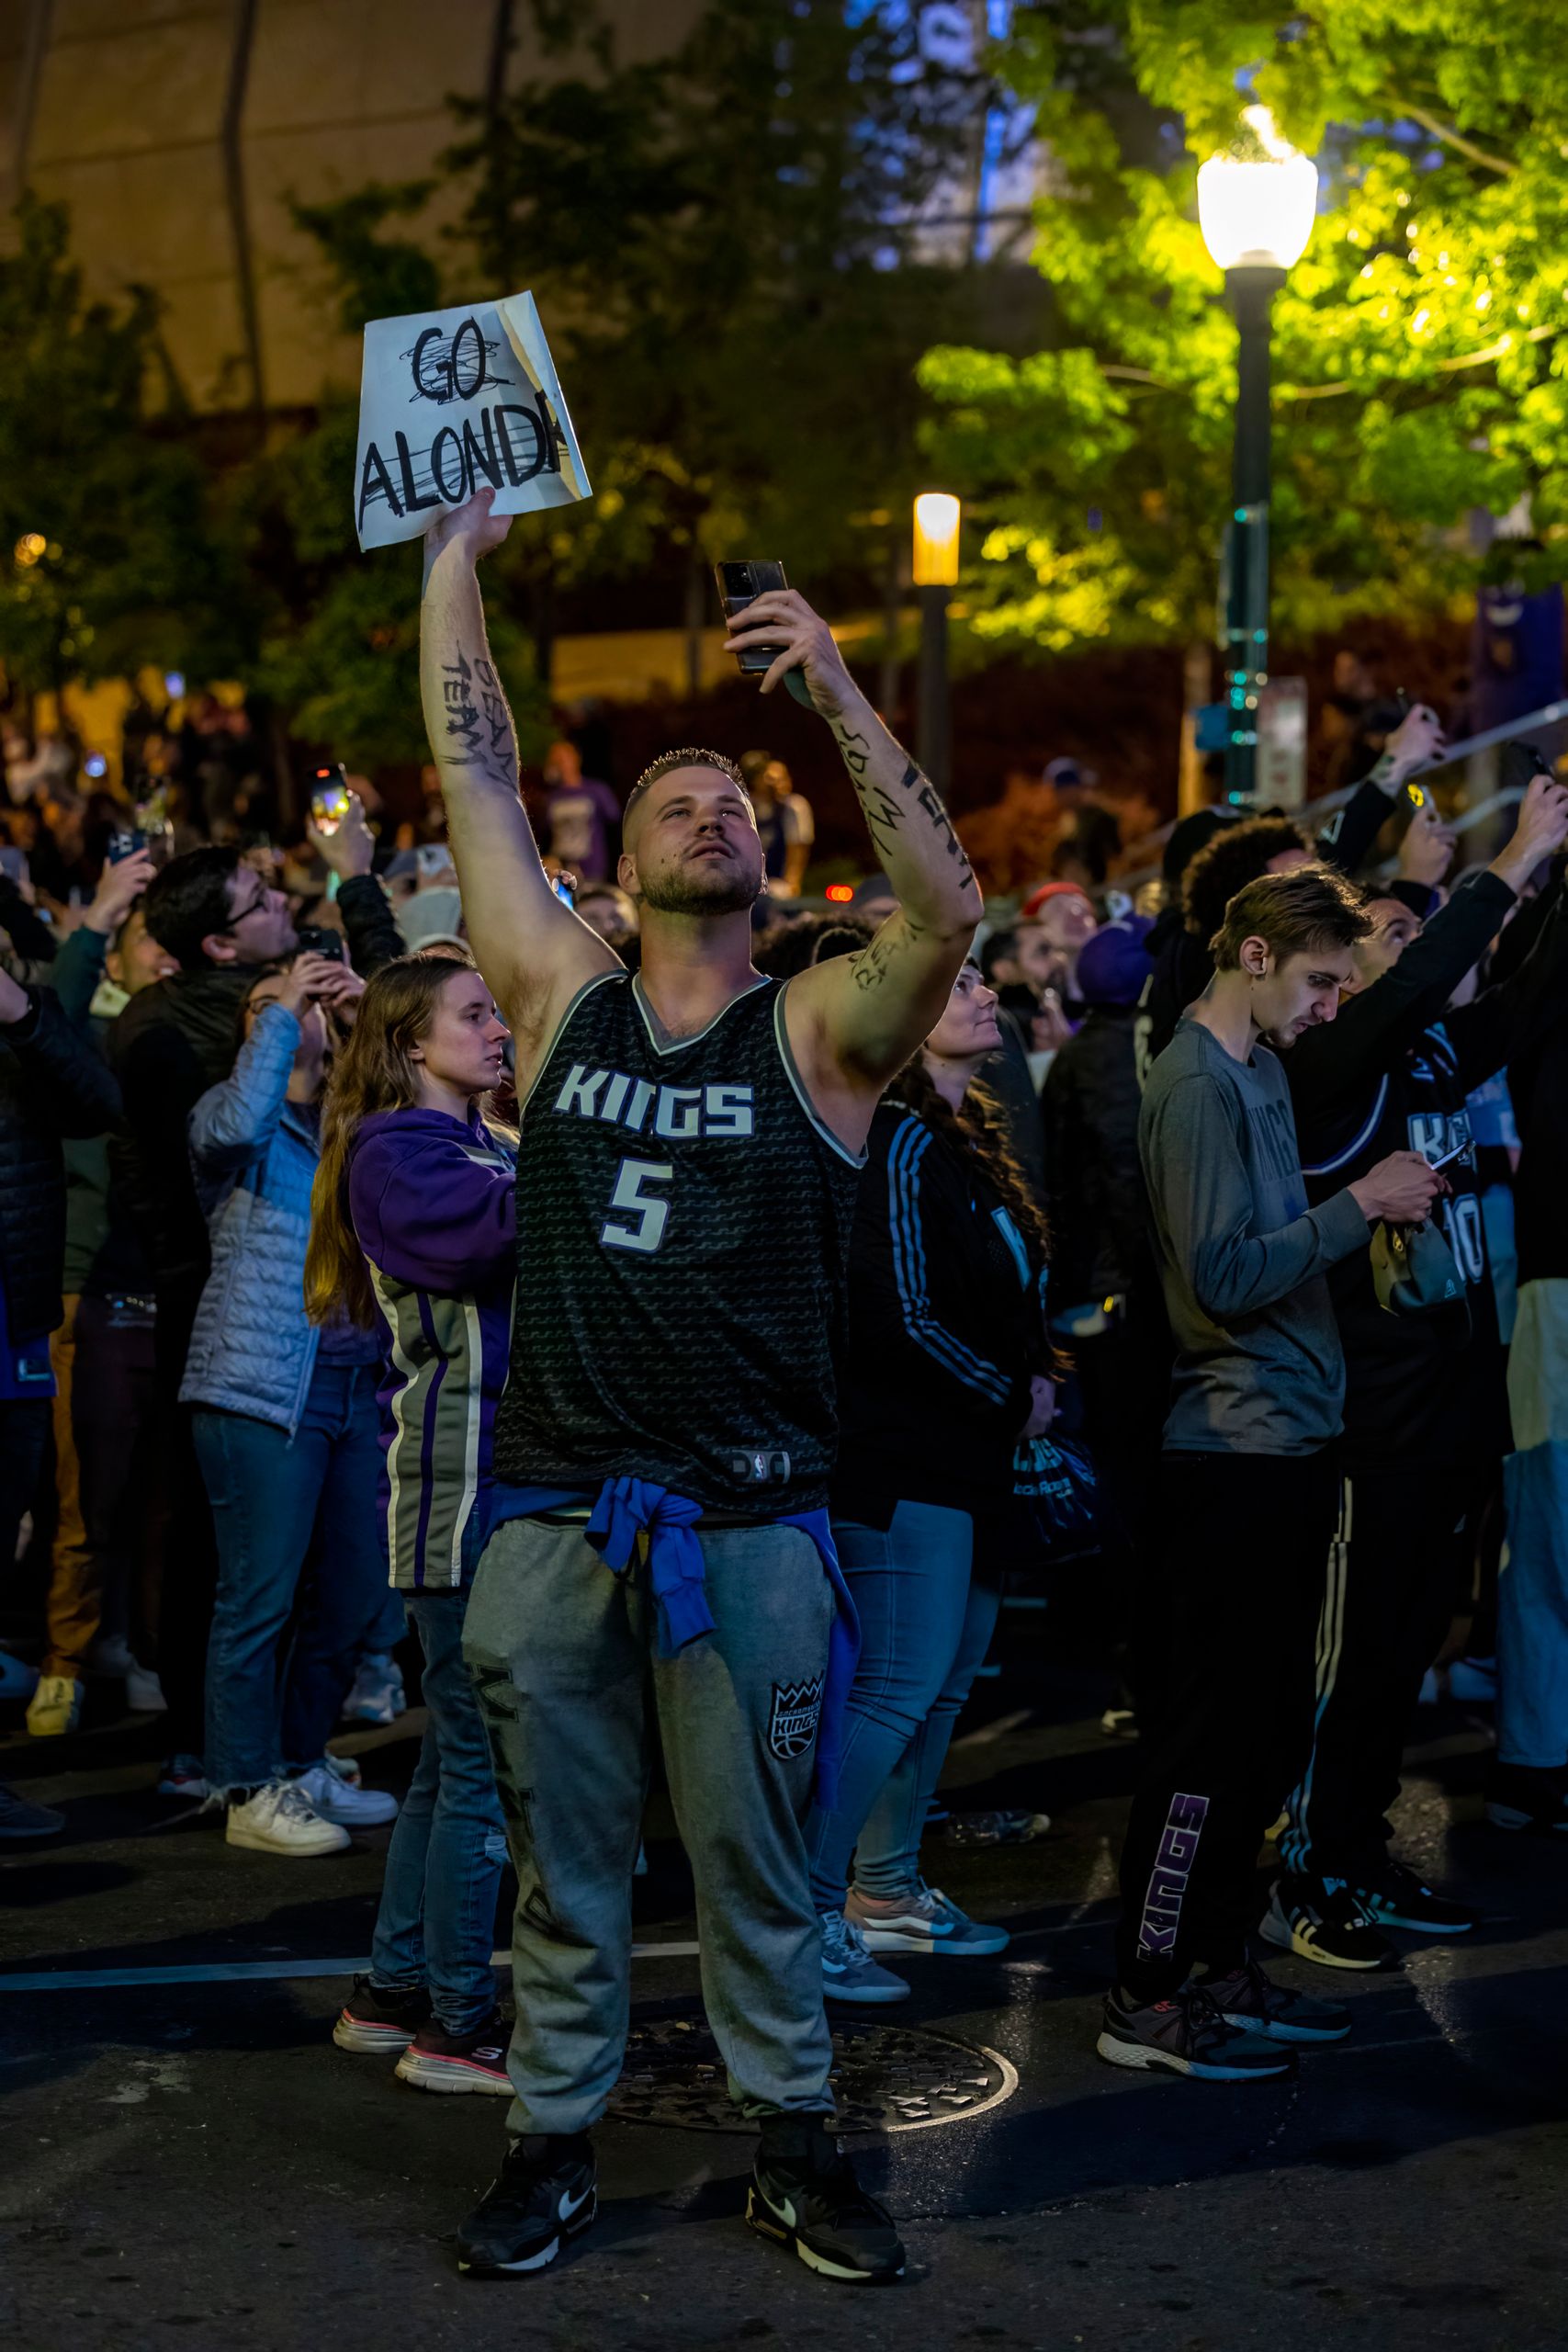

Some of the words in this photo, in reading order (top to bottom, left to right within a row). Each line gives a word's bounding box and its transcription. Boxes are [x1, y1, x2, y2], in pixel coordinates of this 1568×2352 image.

[412, 316, 487, 401] GO
[440, 640, 488, 765] TEAM
[553, 1061, 754, 1139] KINGS
[600, 1156, 675, 1254] 5
[775, 1711, 818, 1735] KINGS
[1136, 1792, 1211, 1962] KINGS
